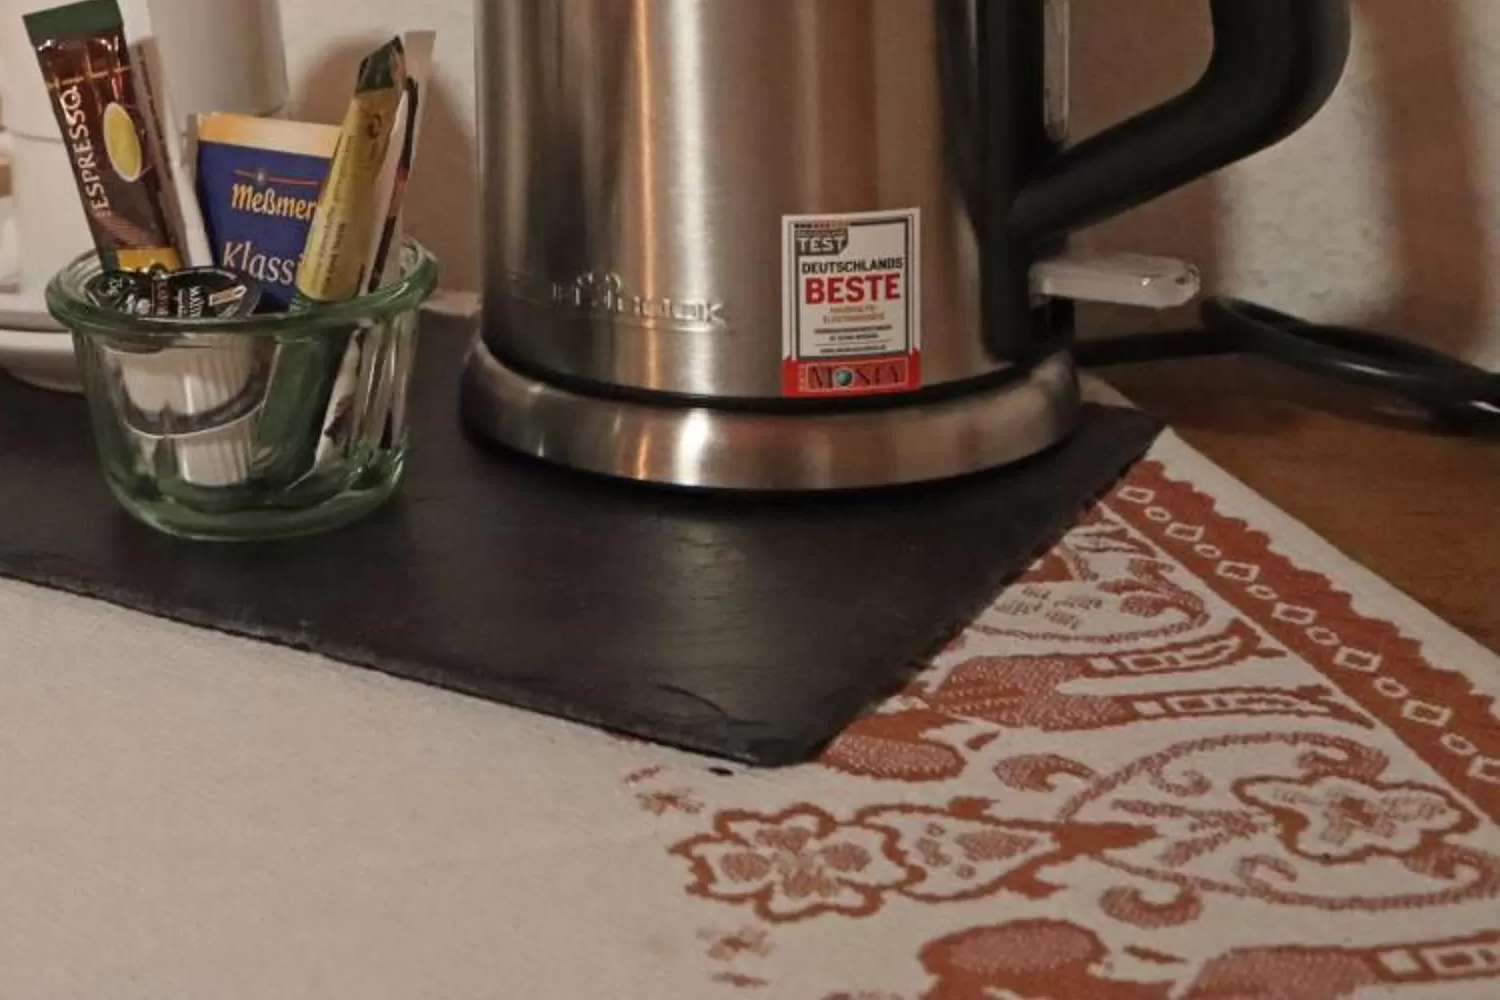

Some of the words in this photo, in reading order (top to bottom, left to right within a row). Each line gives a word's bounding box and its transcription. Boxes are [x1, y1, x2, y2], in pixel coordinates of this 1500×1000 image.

[59, 86, 110, 211] ESPRESSO
[231, 183, 316, 221] Meßmer
[796, 236, 845, 252] TEST
[223, 240, 304, 286] Klass
[801, 257, 903, 275] DEUTSCHLANDS
[804, 273, 901, 305] BESTE
